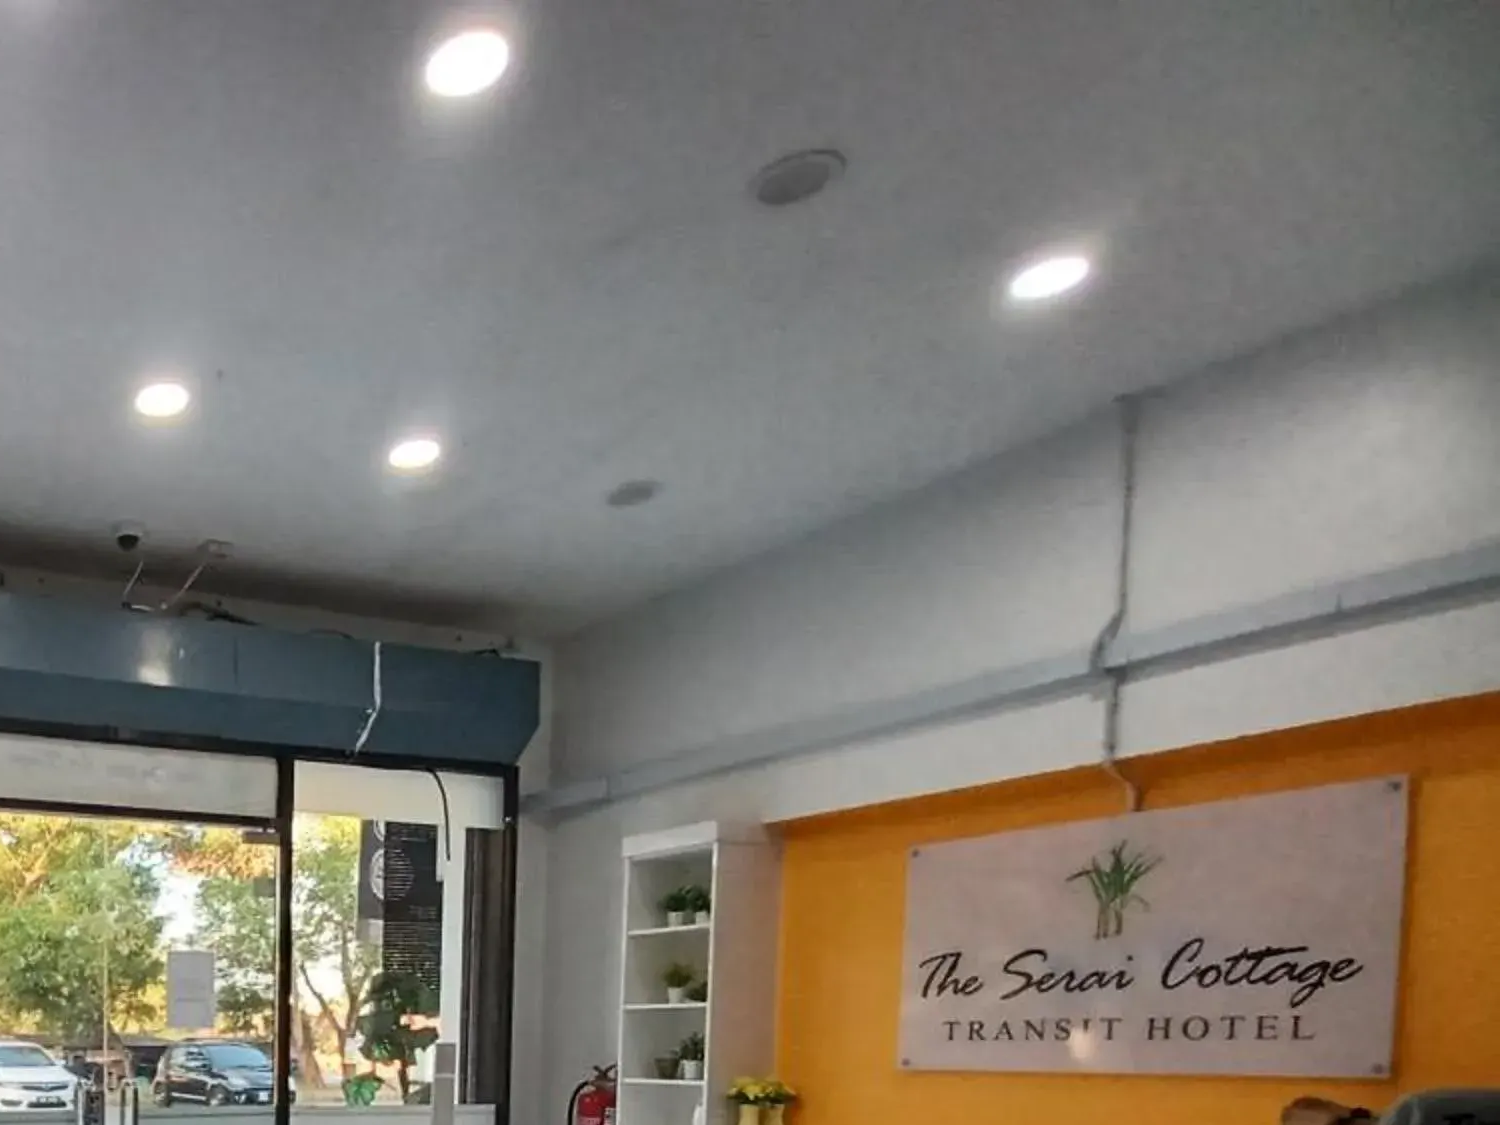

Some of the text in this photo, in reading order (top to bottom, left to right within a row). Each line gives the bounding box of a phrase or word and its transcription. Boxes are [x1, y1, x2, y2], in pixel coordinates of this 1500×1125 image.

[919, 938, 1364, 1007] The Serai Cottage
[943, 1015, 1316, 1041] TRANSIT HOTEL
